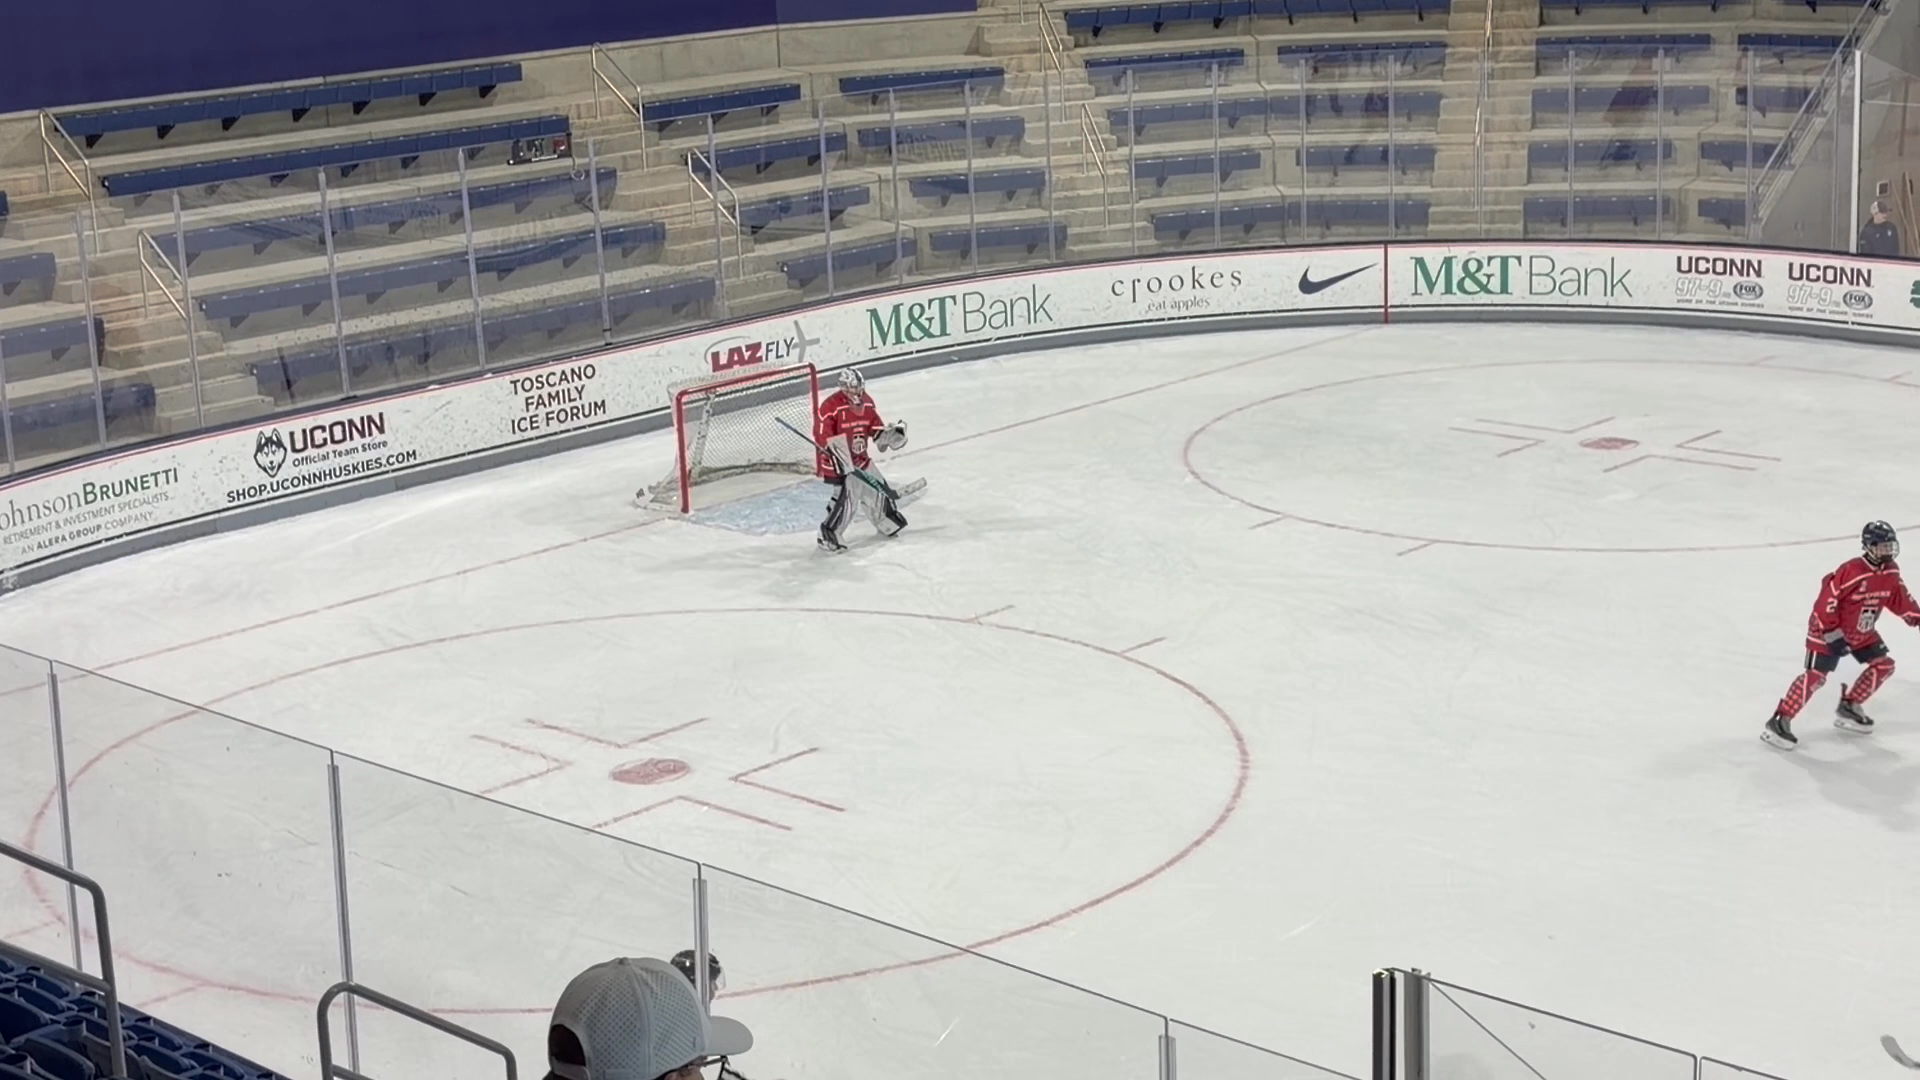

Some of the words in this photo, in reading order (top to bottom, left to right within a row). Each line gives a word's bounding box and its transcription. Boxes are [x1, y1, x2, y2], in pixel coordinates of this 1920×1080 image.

[1111, 265, 1242, 303] crookes
[1410, 255, 1522, 296] M&T
[1528, 255, 1633, 298] Bank
[1676, 256, 1762, 278] UCONN
[1788, 262, 1872, 288] UCONN
[866, 295, 958, 350] M&T
[962, 284, 1054, 334] Bank
[510, 364, 596, 395] TOSCANO
[511, 414, 540, 435] ICE
[545, 399, 606, 427] FORUM
[525, 384, 585, 413] FAMILY
[289, 412, 386, 453] UCONN
[292, 451, 330, 468] Official
[332, 446, 360, 459] Team
[361, 439, 388, 453] Store
[226, 449, 418, 504] SHOP.UCONNHUSKIES.COM
[3, 521, 53, 545] RETIREMENT
[54, 520, 62, 531] &
[62, 502, 116, 527] INVESTMENT
[117, 491, 169, 513] SPECIALISTS
[21, 543, 35, 555] AN
[36, 534, 68, 551] ALERA
[68, 523, 103, 541] GROUP
[104, 511, 153, 531] COMPANY
[1826, 597, 1838, 613] 2
